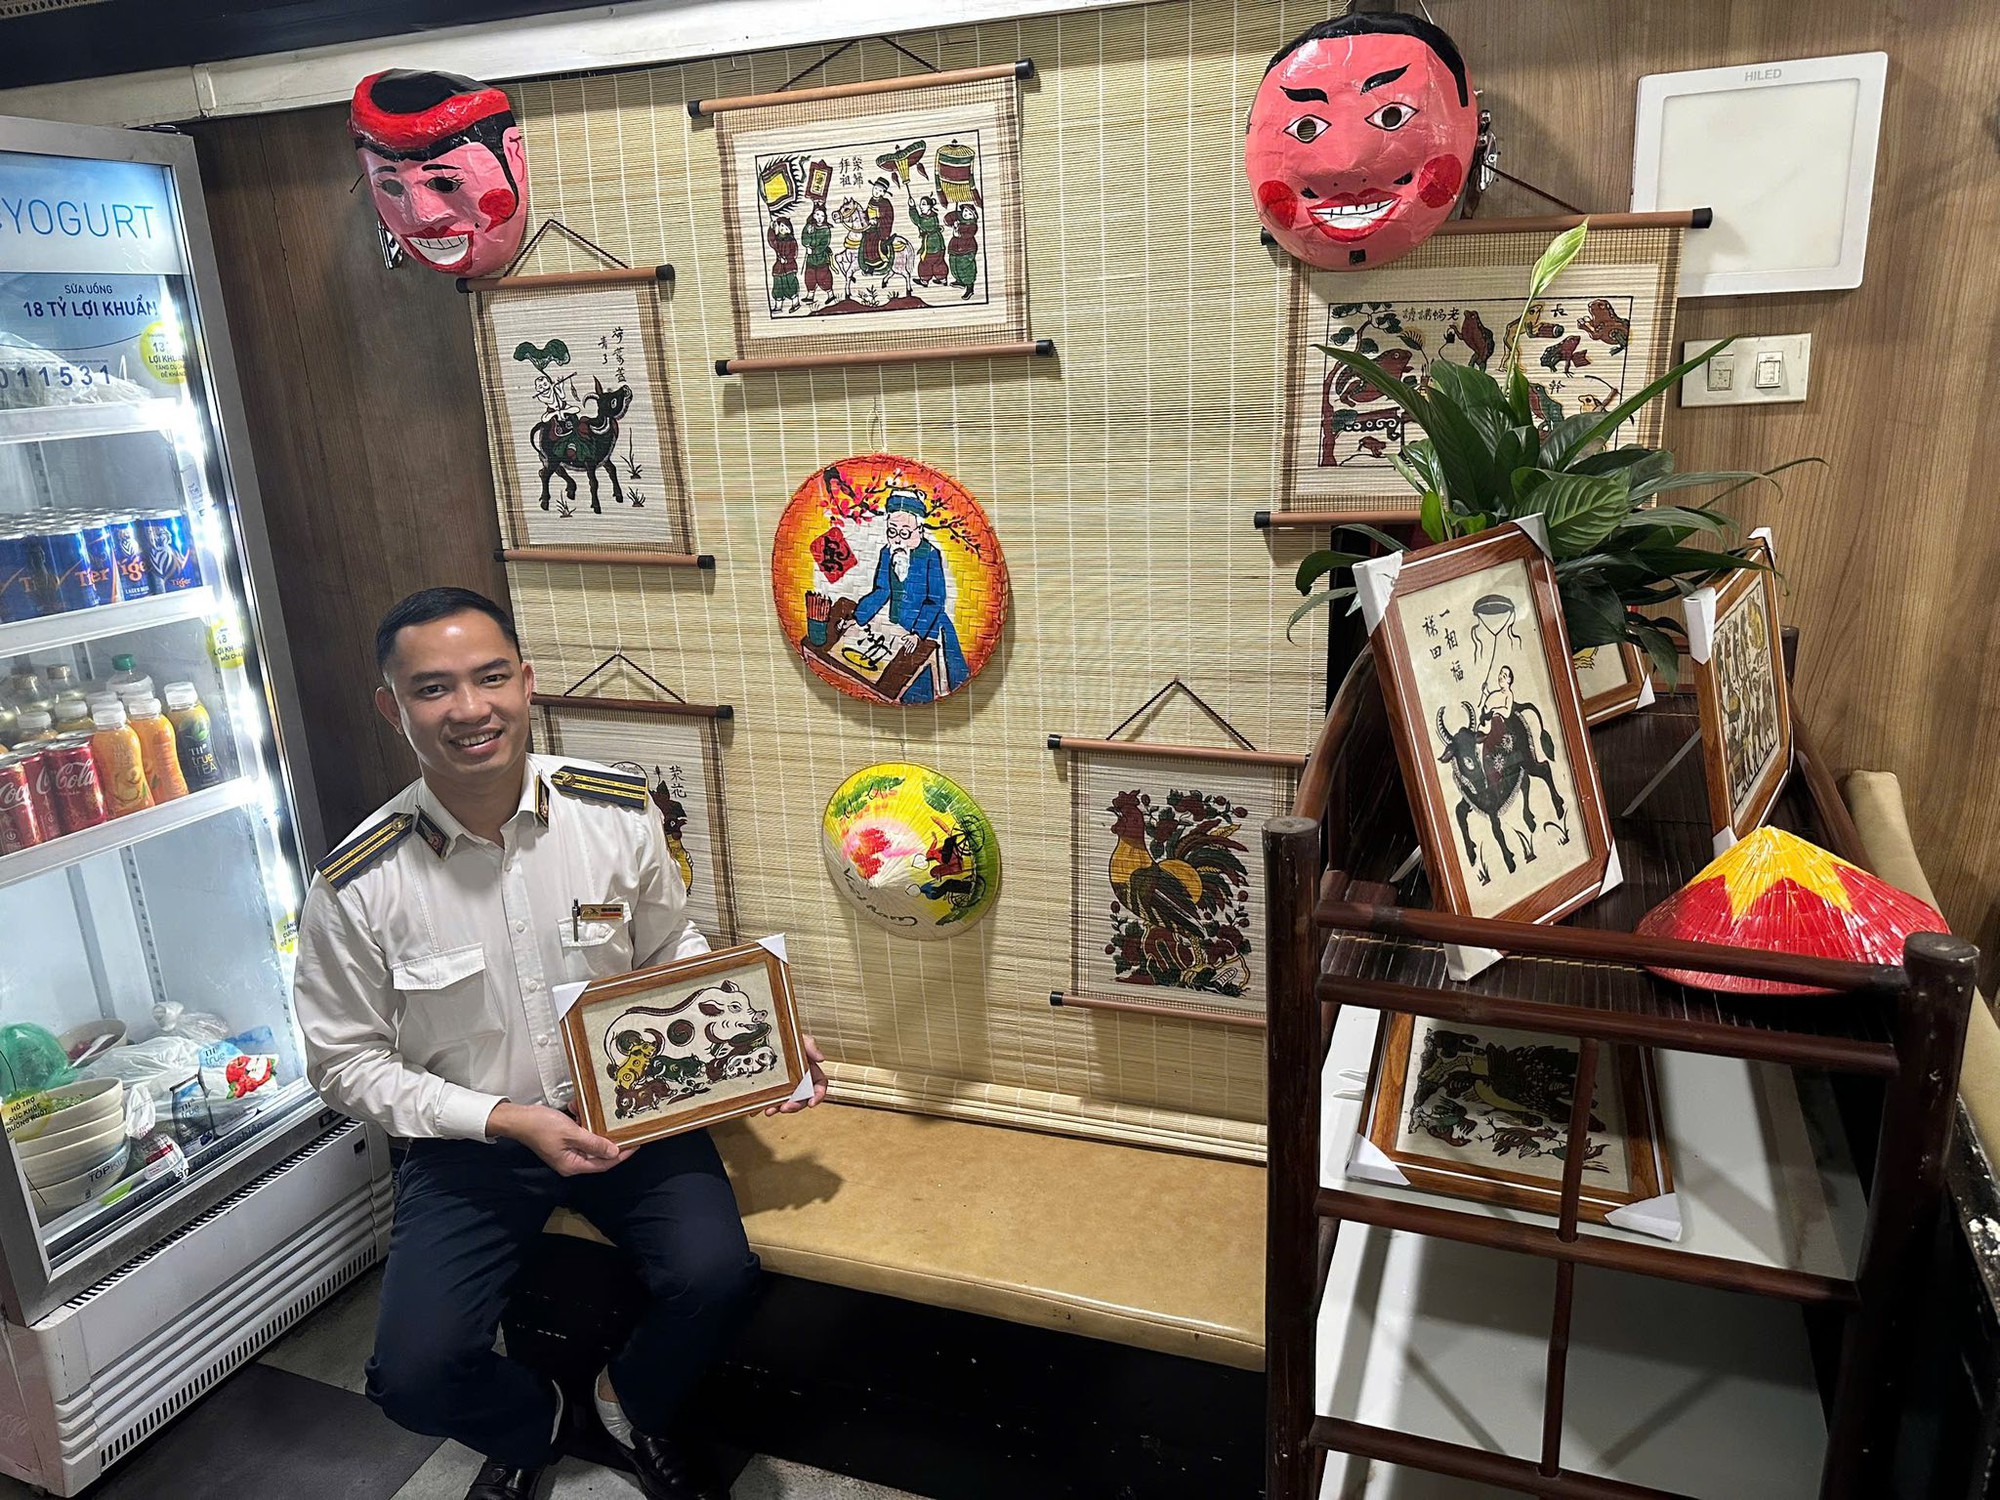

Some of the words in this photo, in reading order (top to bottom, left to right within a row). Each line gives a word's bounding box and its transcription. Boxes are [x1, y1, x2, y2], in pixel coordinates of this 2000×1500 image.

[1744, 68, 1782, 82] HILED
[2, 197, 154, 239] YOGURT
[86, 281, 113, 294] UỐNG
[23, 301, 44, 317] 18
[46, 296, 67, 317] TỶ
[72, 299, 99, 320] LỢI
[192, 753, 214, 766] true
[56, 759, 94, 790] Cola
[206, 1051, 226, 1066] true
[88, 1155, 128, 1182] TOPKID
